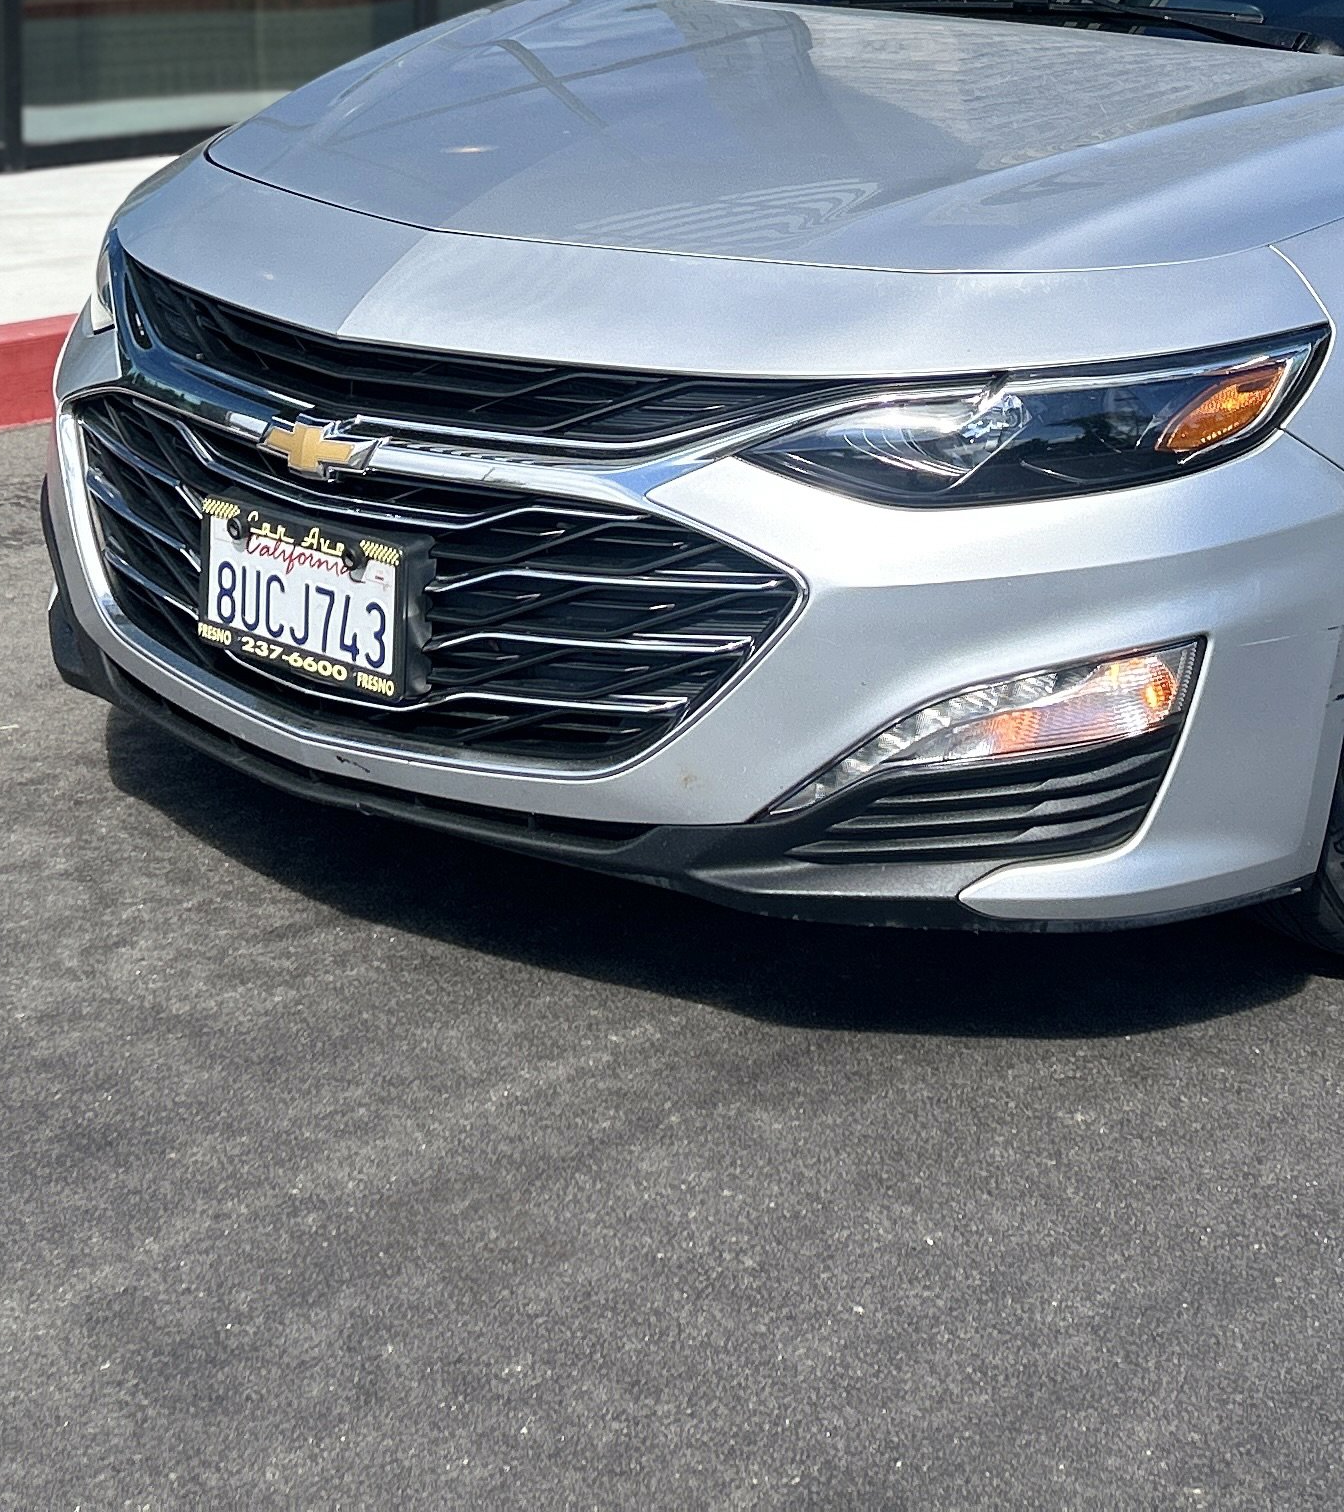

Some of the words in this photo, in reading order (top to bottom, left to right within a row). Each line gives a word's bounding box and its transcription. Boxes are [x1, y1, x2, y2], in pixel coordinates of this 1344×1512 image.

[246, 535, 355, 576] California
[248, 511, 295, 543] Car
[217, 560, 386, 668] 8UCJ743
[198, 622, 231, 646] FRESNO
[241, 636, 348, 681] 237-6600
[356, 672, 395, 696] FRESNO
